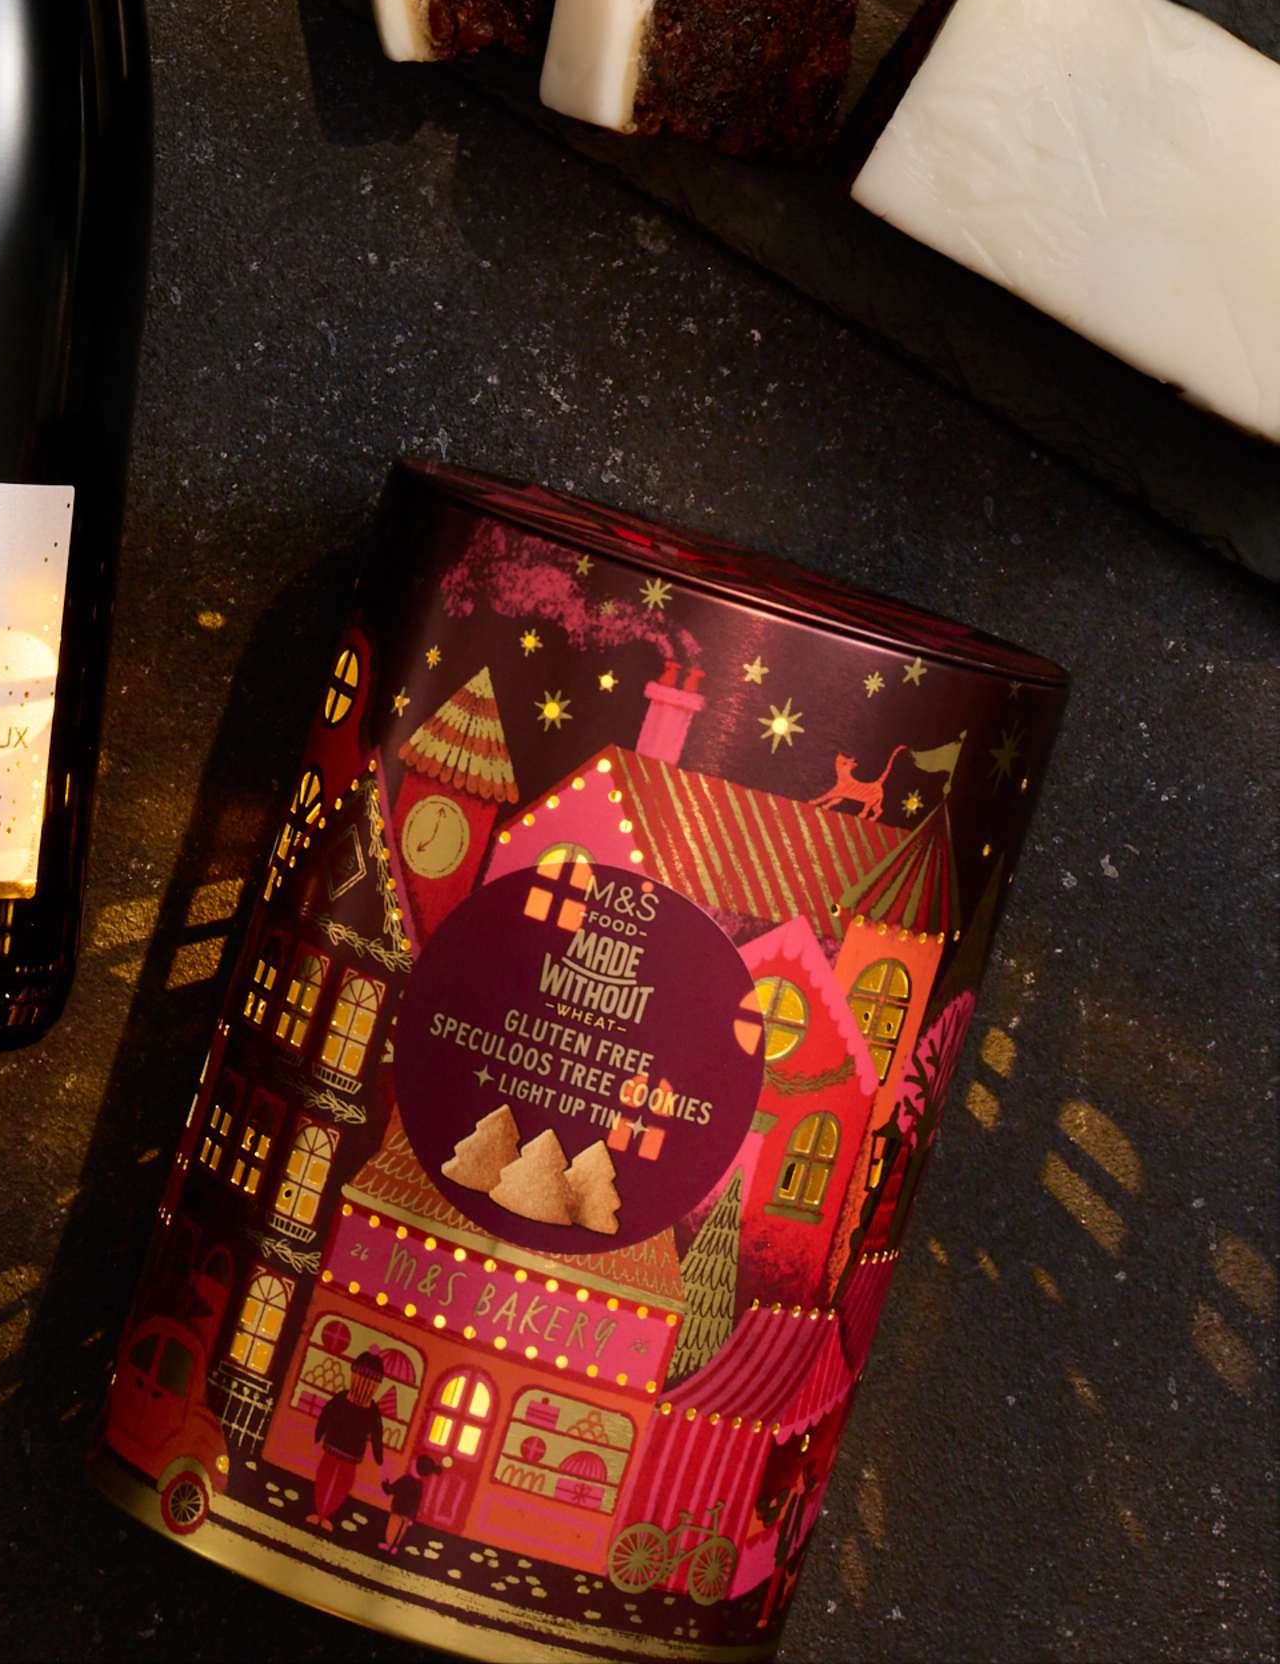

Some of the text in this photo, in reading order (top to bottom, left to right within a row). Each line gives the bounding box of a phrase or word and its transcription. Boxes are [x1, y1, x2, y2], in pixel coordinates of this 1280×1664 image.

[583, 875, 660, 922] M&S
[566, 928, 645, 978] MADE
[539, 952, 655, 1024] WITHOUT
[429, 1012, 713, 1125] SPECULOOS TREE COOKIES
[504, 1009, 654, 1076] GLUTEN FREE
[498, 1073, 622, 1130] LIGHT UP TIN
[384, 1242, 468, 1306] M&S
[475, 1282, 617, 1358] BAKERY
